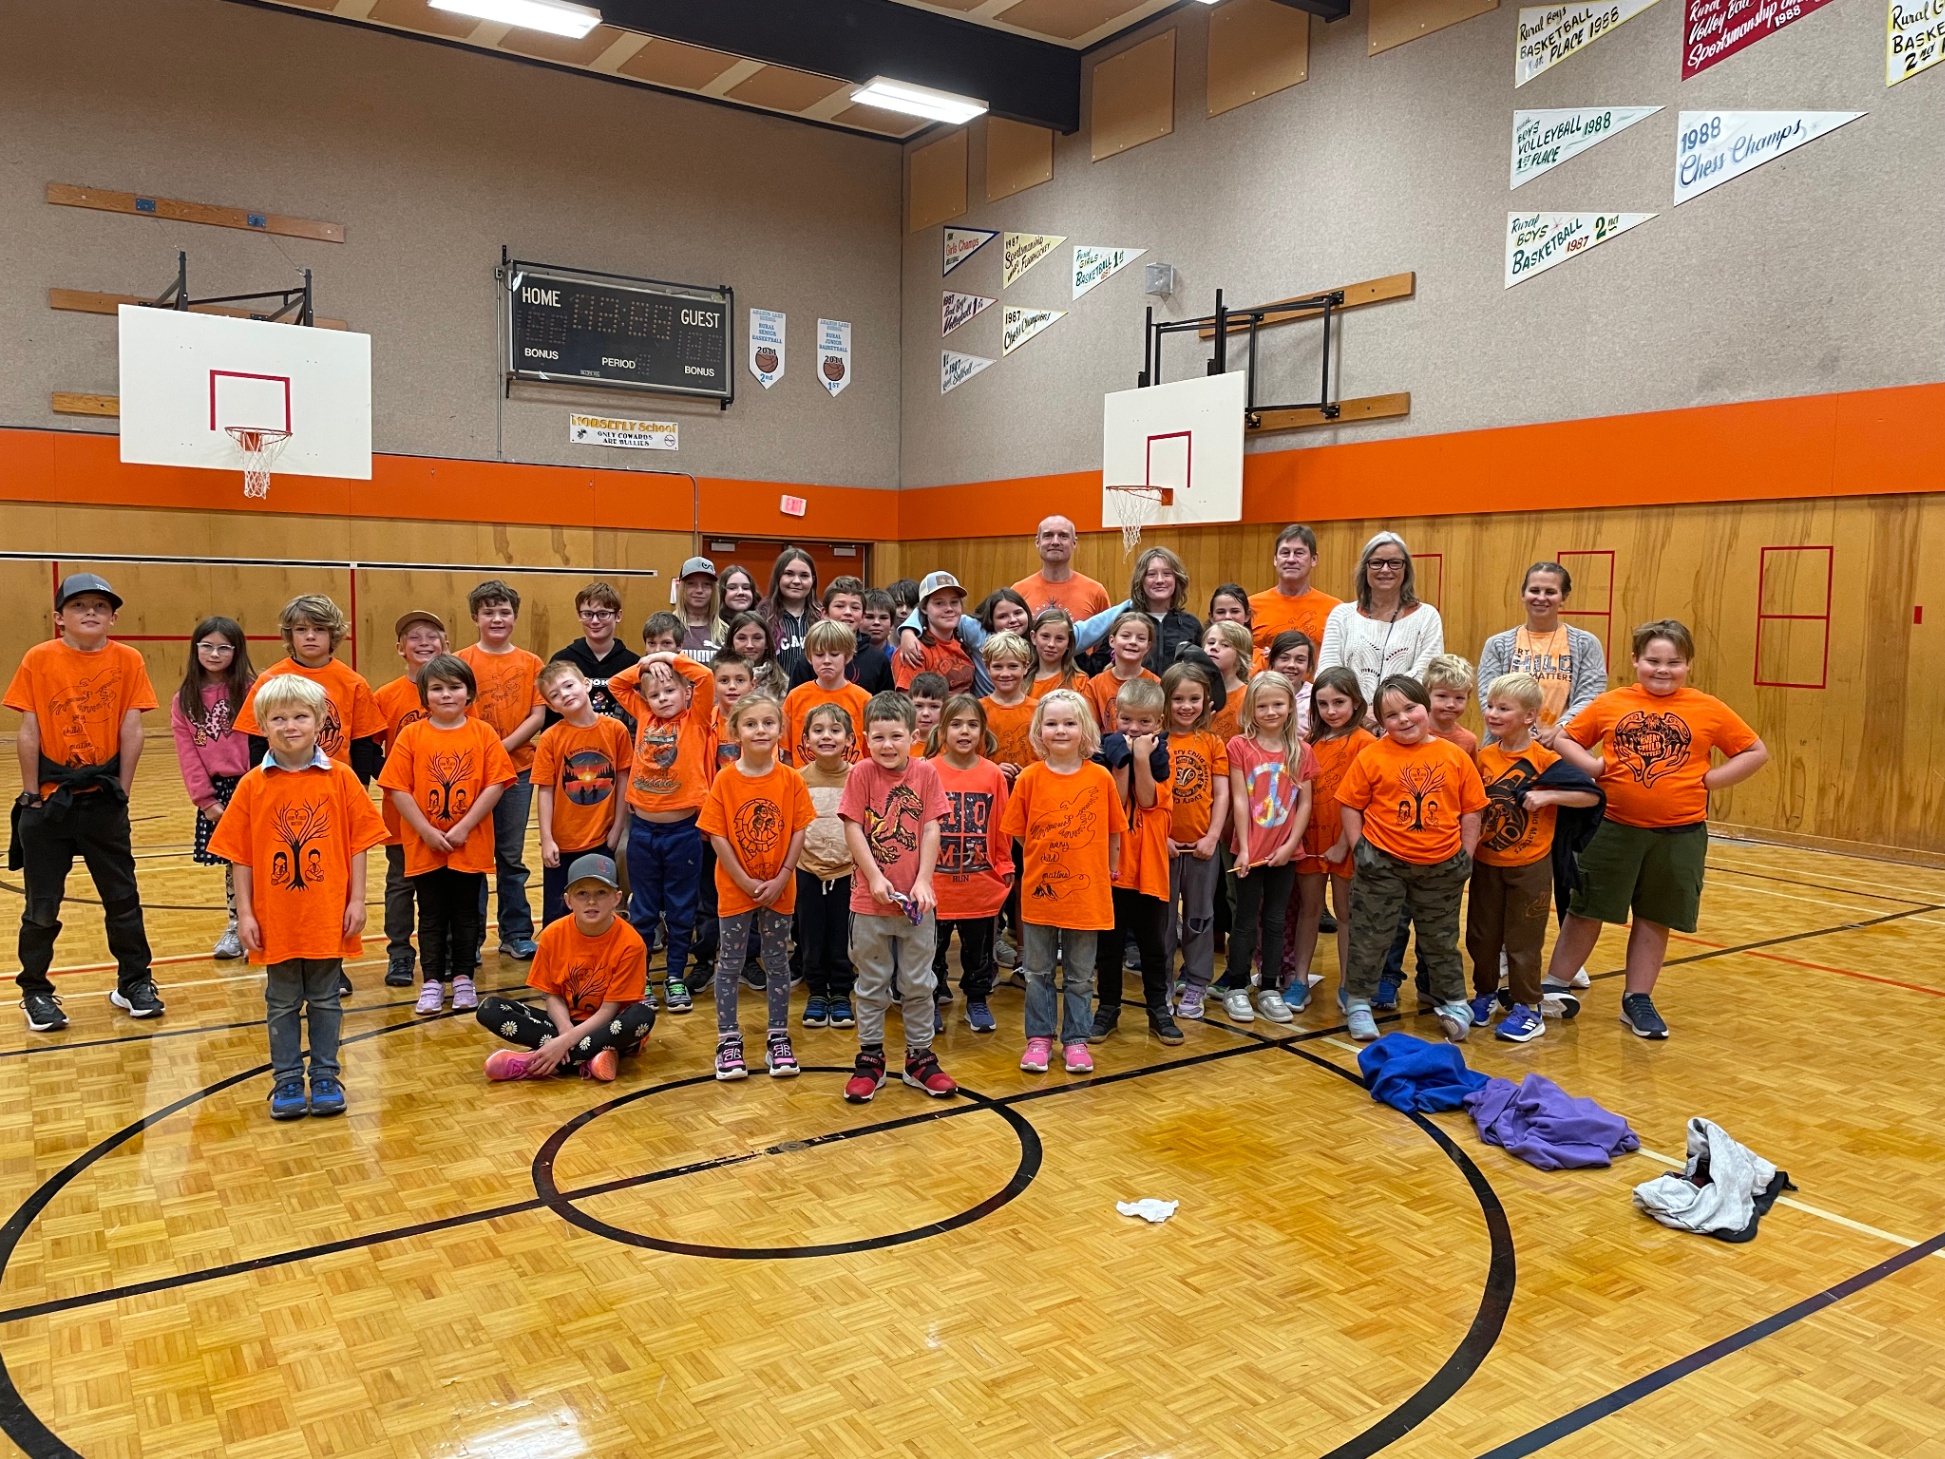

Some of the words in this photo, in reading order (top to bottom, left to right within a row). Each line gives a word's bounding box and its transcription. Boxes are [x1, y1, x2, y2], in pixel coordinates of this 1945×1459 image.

[1774, 5, 1801, 27] 1988
[1892, 5, 1930, 30] Rural
[1520, 16, 1544, 41] Rural
[1520, 8, 1593, 59] BASKETBALL
[1549, 28, 1584, 62] PLACE
[1589, 6, 1619, 38] 1988
[1687, 0, 1778, 69] Sportsmanship
[1688, 11, 1726, 45] Volley
[1905, 42, 1936, 72] 2nd
[1517, 120, 1540, 142] BOYS
[1518, 115, 1582, 155] VOLLEYBALL
[1584, 111, 1612, 136] 1988
[1681, 116, 1722, 154] 1988
[1531, 146, 1561, 166] PLACE
[1680, 153, 1725, 186] Chess
[1730, 119, 1802, 163] Champs
[1511, 214, 1540, 234] Rural
[1512, 218, 1583, 274] BASKETBALL
[1595, 215, 1620, 241] 2nd
[1516, 224, 1549, 247] BOYS
[1567, 235, 1590, 252] 1987
[1076, 257, 1112, 286] BASKETBALL
[522, 286, 561, 307] HOME
[681, 309, 720, 328] GUEST
[1005, 310, 1021, 325] 1987
[524, 347, 559, 360] BONUS
[602, 357, 636, 369] PERIOD
[684, 365, 715, 377] BONUS
[760, 373, 774, 383] 2nd
[828, 381, 841, 391] 1ST
[638, 422, 677, 433] School
[1637, 741, 1661, 752] CHILD
